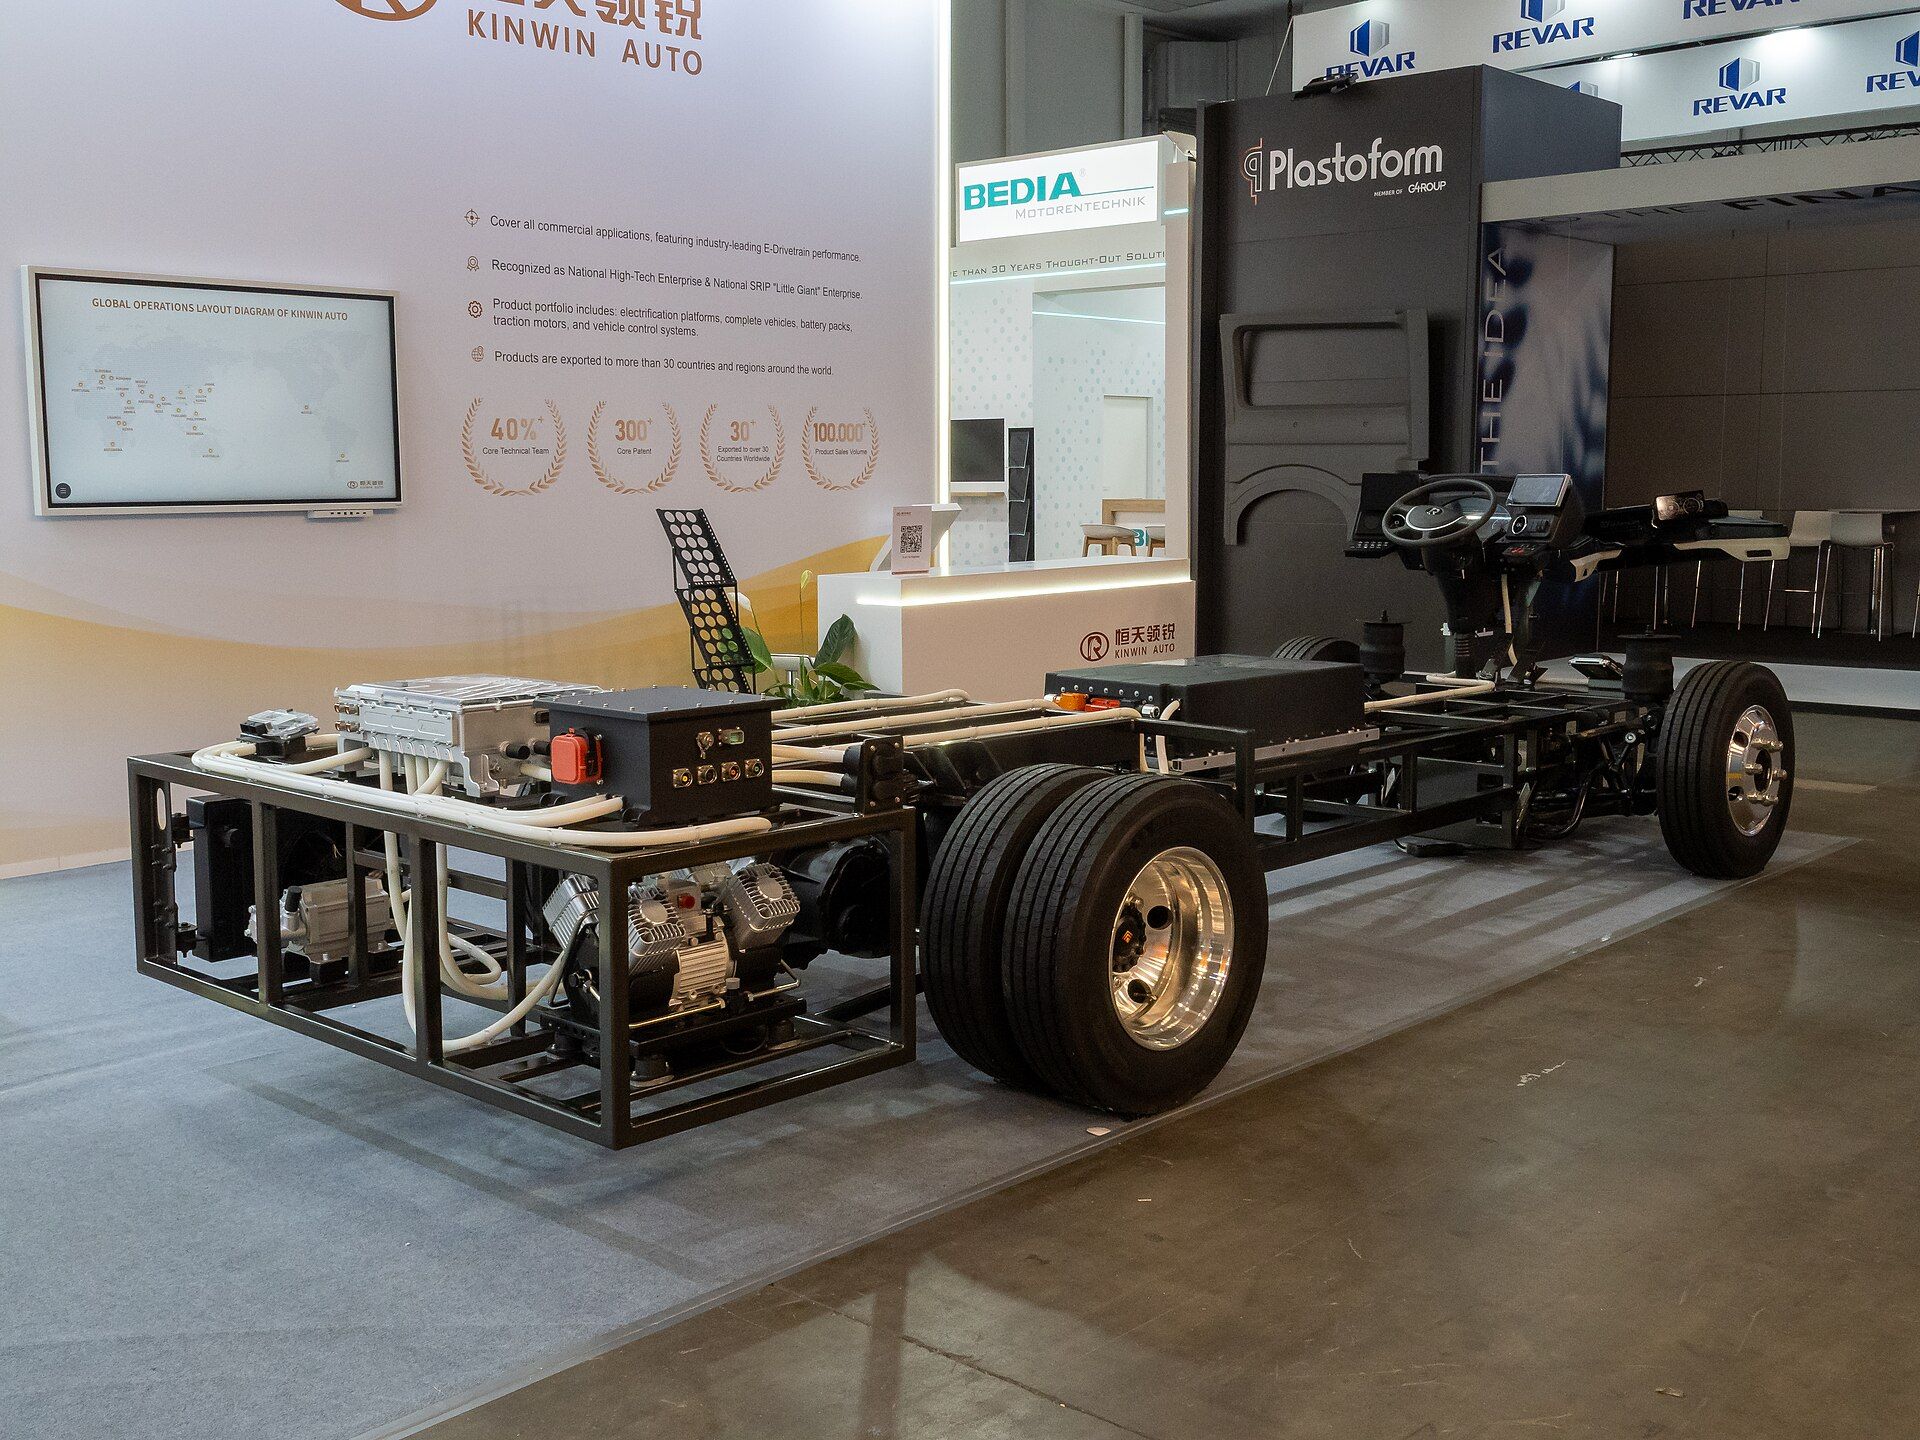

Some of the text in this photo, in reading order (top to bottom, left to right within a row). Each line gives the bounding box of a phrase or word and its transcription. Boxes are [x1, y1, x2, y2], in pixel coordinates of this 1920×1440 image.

[499, 0, 702, 40] 领锐
[1493, 17, 1595, 53] REVAR
[468, 8, 702, 76] KINWIN AUTO
[1693, 88, 1786, 116] REVAR
[1270, 138, 1442, 190] Plastoform
[490, 216, 862, 262] Cover all commercial applications, featuring industry-leading E-Drivetrain performance.
[492, 260, 550, 275] Recognized
[554, 267, 565, 276] as
[568, 266, 606, 279] National
[610, 270, 655, 283] High-Tech
[658, 272, 702, 288] Enterprise
[705, 277, 712, 287] &
[714, 278, 748, 290] National
[750, 281, 770, 292] SRIP
[823, 287, 862, 300] Enterprise.
[992, 264, 1006, 274] 30
[92, 298, 348, 321] GLOBAL OPERATIONS LAYOUT DIAGRAM OF KINWIN AUTO
[494, 298, 852, 333] Product portfolio includes: electrification platforms, complete vehicles, battery packs,
[1485, 247, 1507, 358] IDEA
[494, 315, 698, 338] traction motors, and vehicle control systems.
[495, 351, 834, 376] Products are exported to more than 30 countries and regions around the world.
[482, 447, 550, 455] Core Technical Team
[1115, 622, 1175, 646] 恒天领锐
[1115, 644, 1174, 659] KINWIN AUTO
